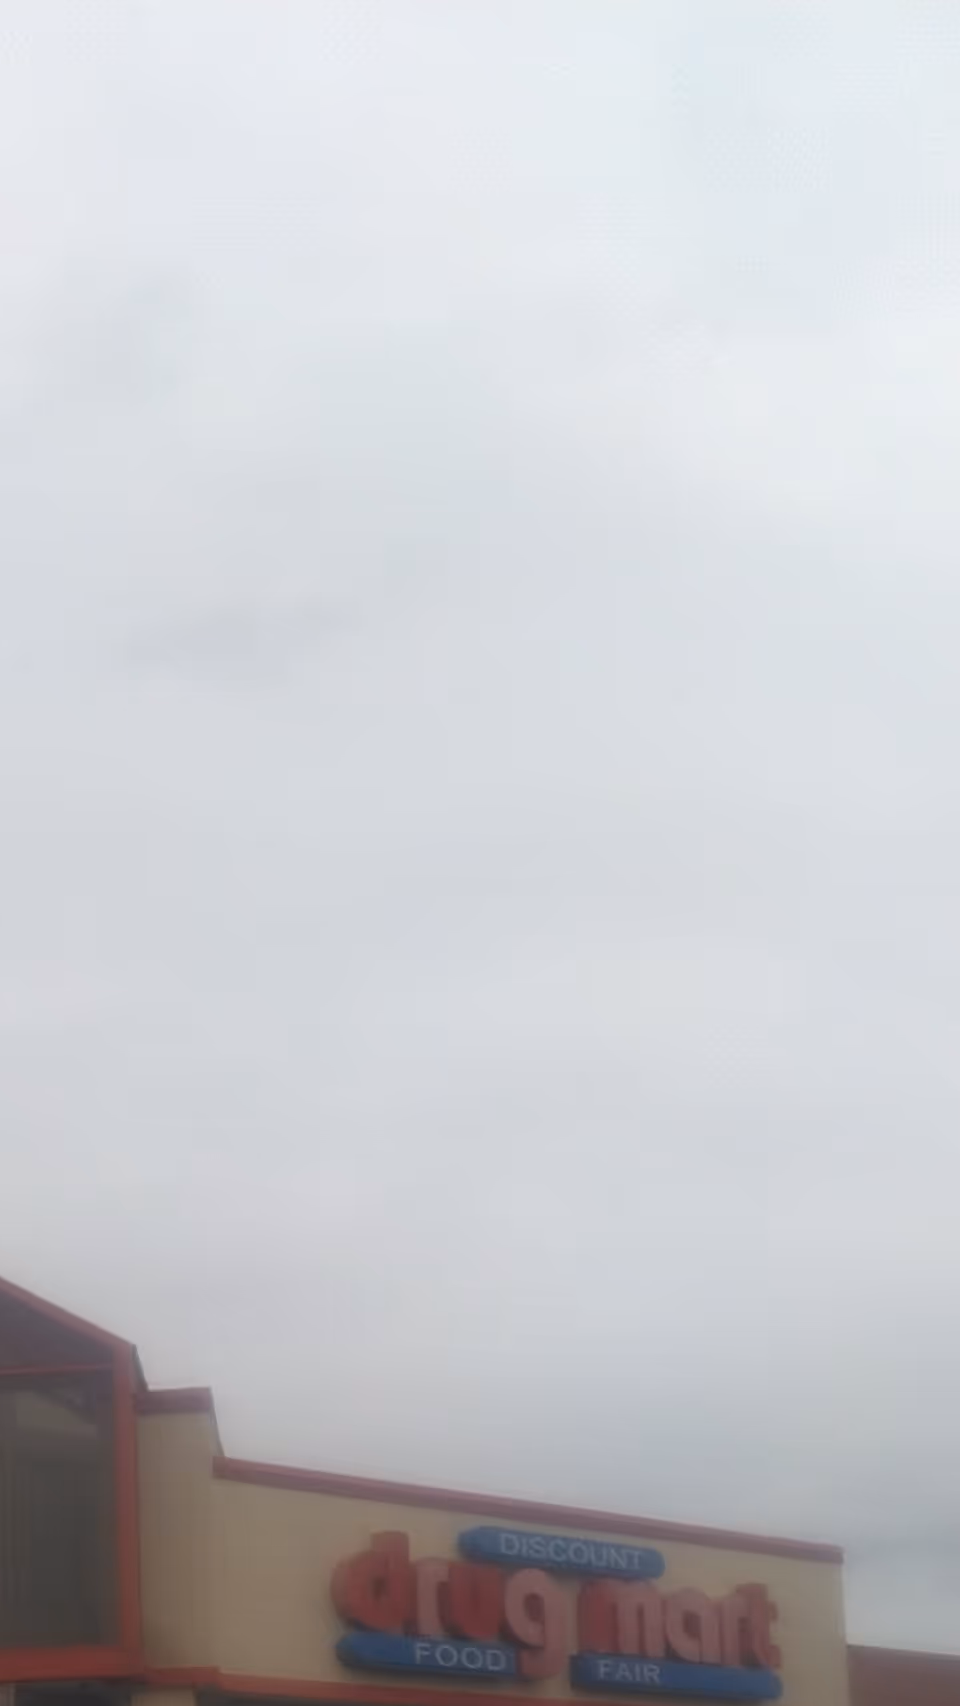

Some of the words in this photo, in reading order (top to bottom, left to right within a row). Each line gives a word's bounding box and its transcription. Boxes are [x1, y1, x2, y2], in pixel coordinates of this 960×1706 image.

[499, 1531, 646, 1572] DISCOUNT
[331, 1530, 568, 1681] drug
[577, 1577, 782, 1669] mart
[414, 1641, 507, 1673] FOOD
[597, 1658, 662, 1685] FAIR
